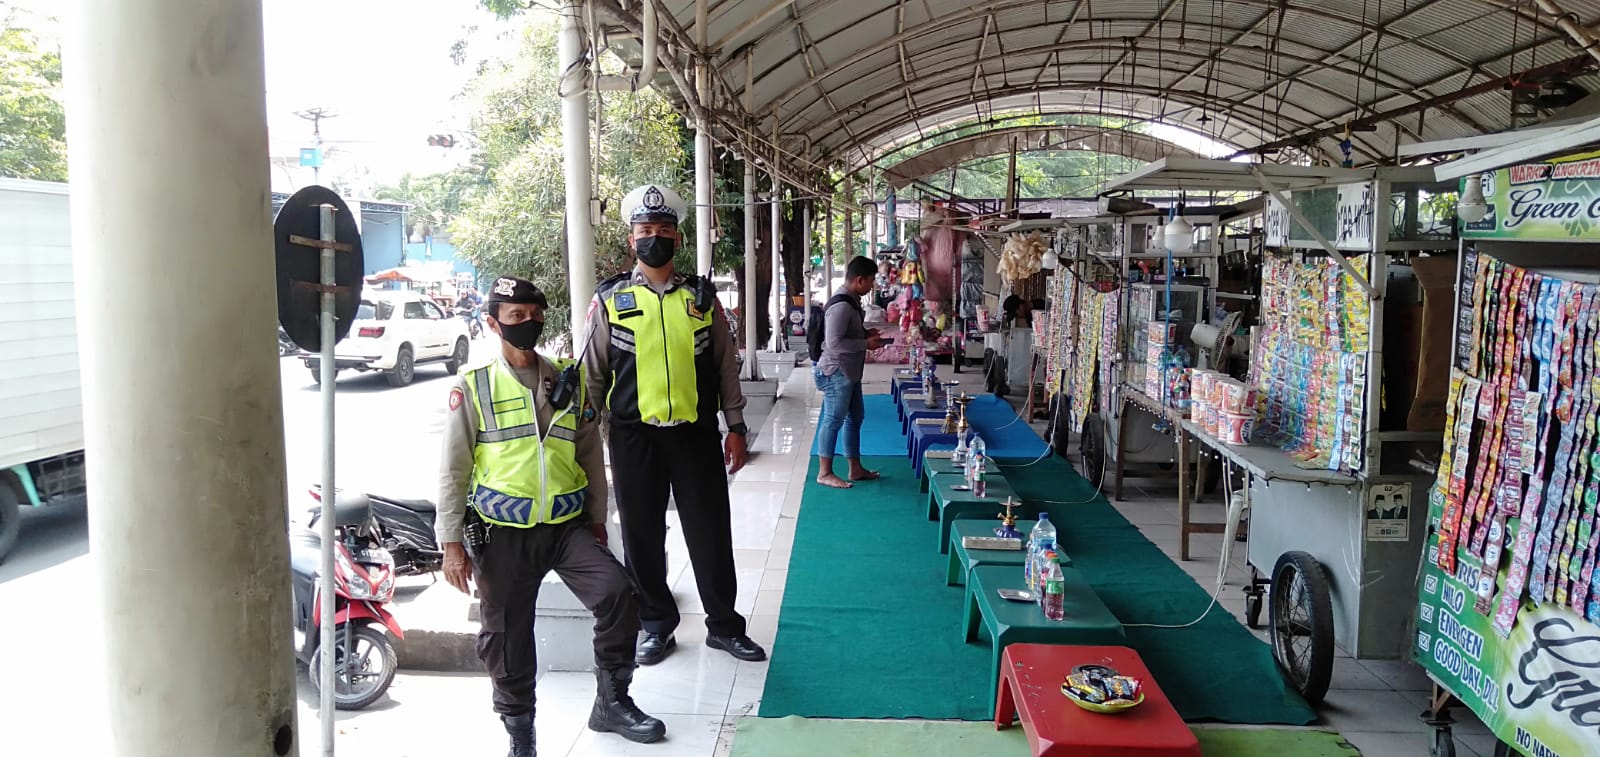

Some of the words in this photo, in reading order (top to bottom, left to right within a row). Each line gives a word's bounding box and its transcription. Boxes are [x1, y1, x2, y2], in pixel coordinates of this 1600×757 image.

[1504, 188, 1581, 227] Green
[1440, 611, 1483, 659] ENERGEN
[1435, 640, 1461, 674] GOOD
[1516, 727, 1531, 749] NO
